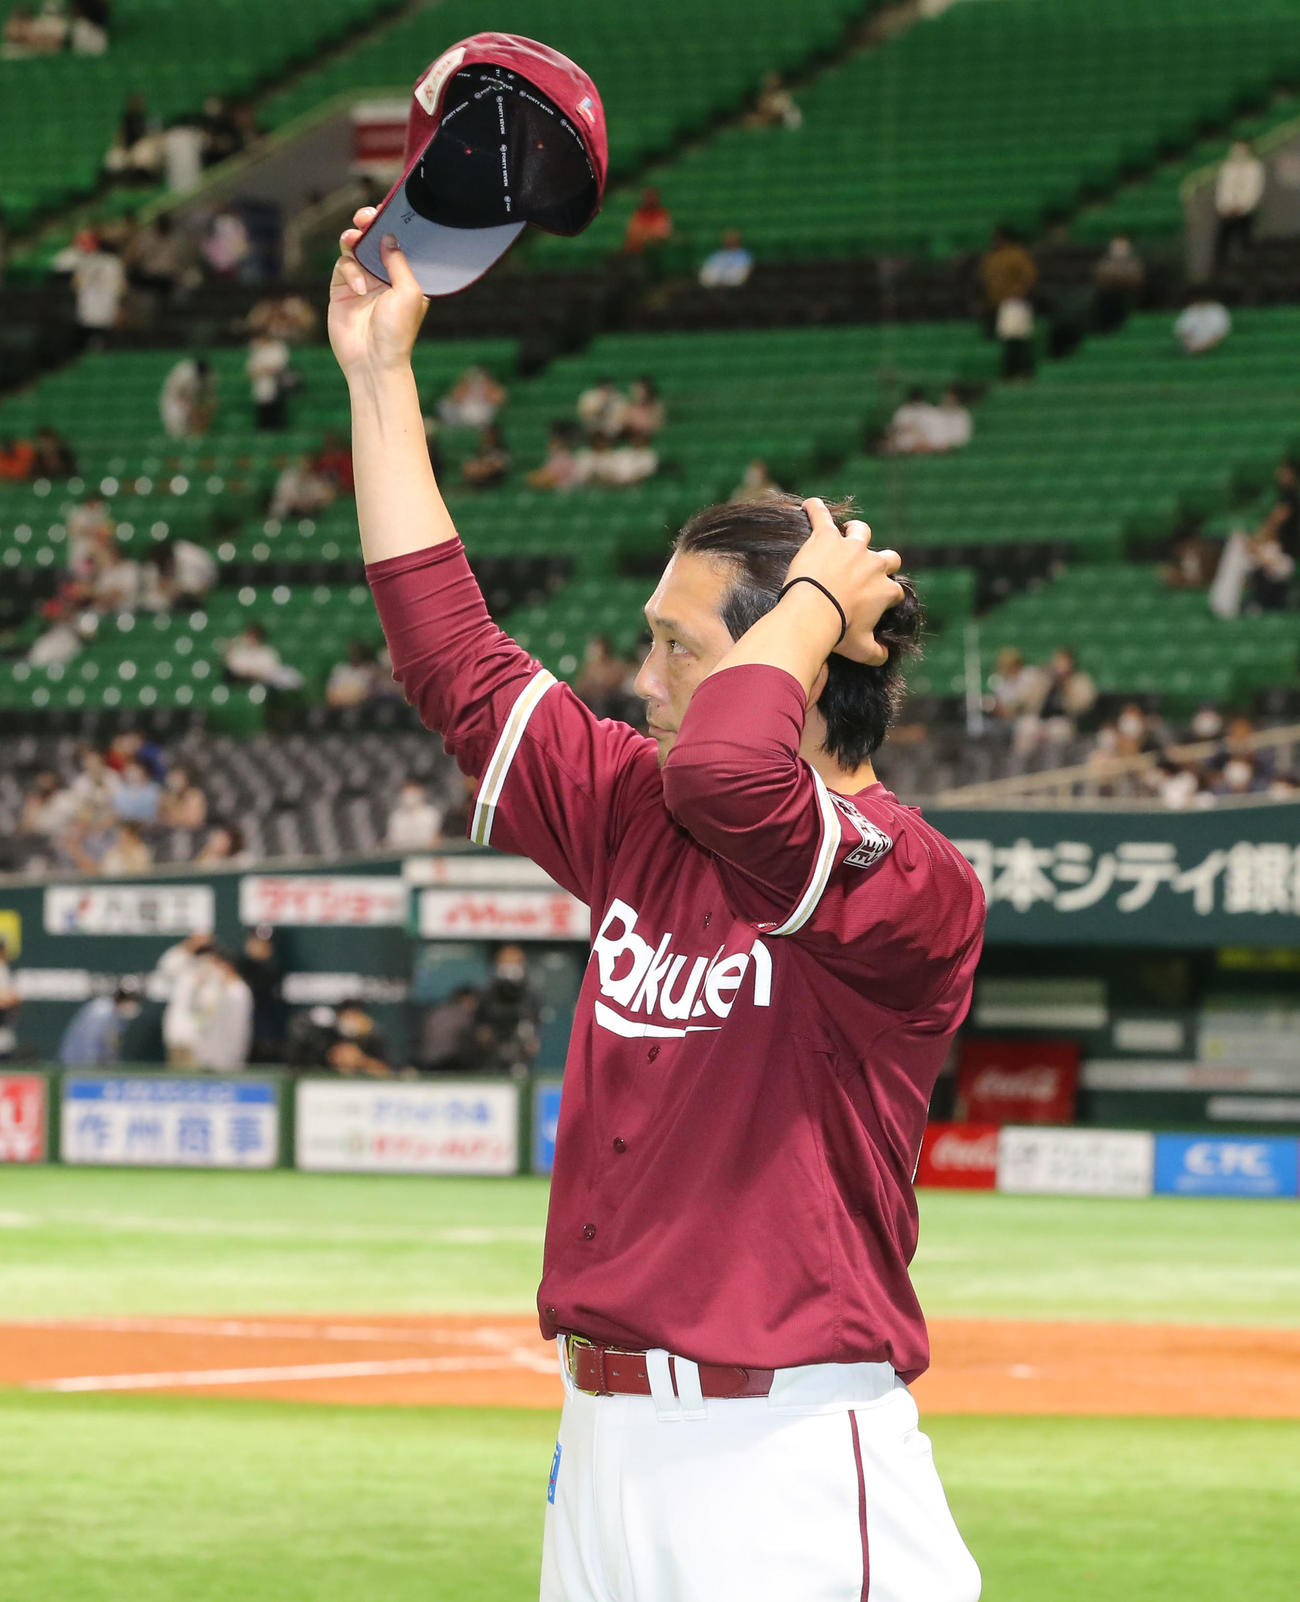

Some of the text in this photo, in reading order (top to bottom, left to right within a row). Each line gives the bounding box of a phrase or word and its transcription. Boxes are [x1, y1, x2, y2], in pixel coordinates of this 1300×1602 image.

[950, 838, 1300, 915] 本シティ銀
[589, 897, 773, 1020] Rakuen
